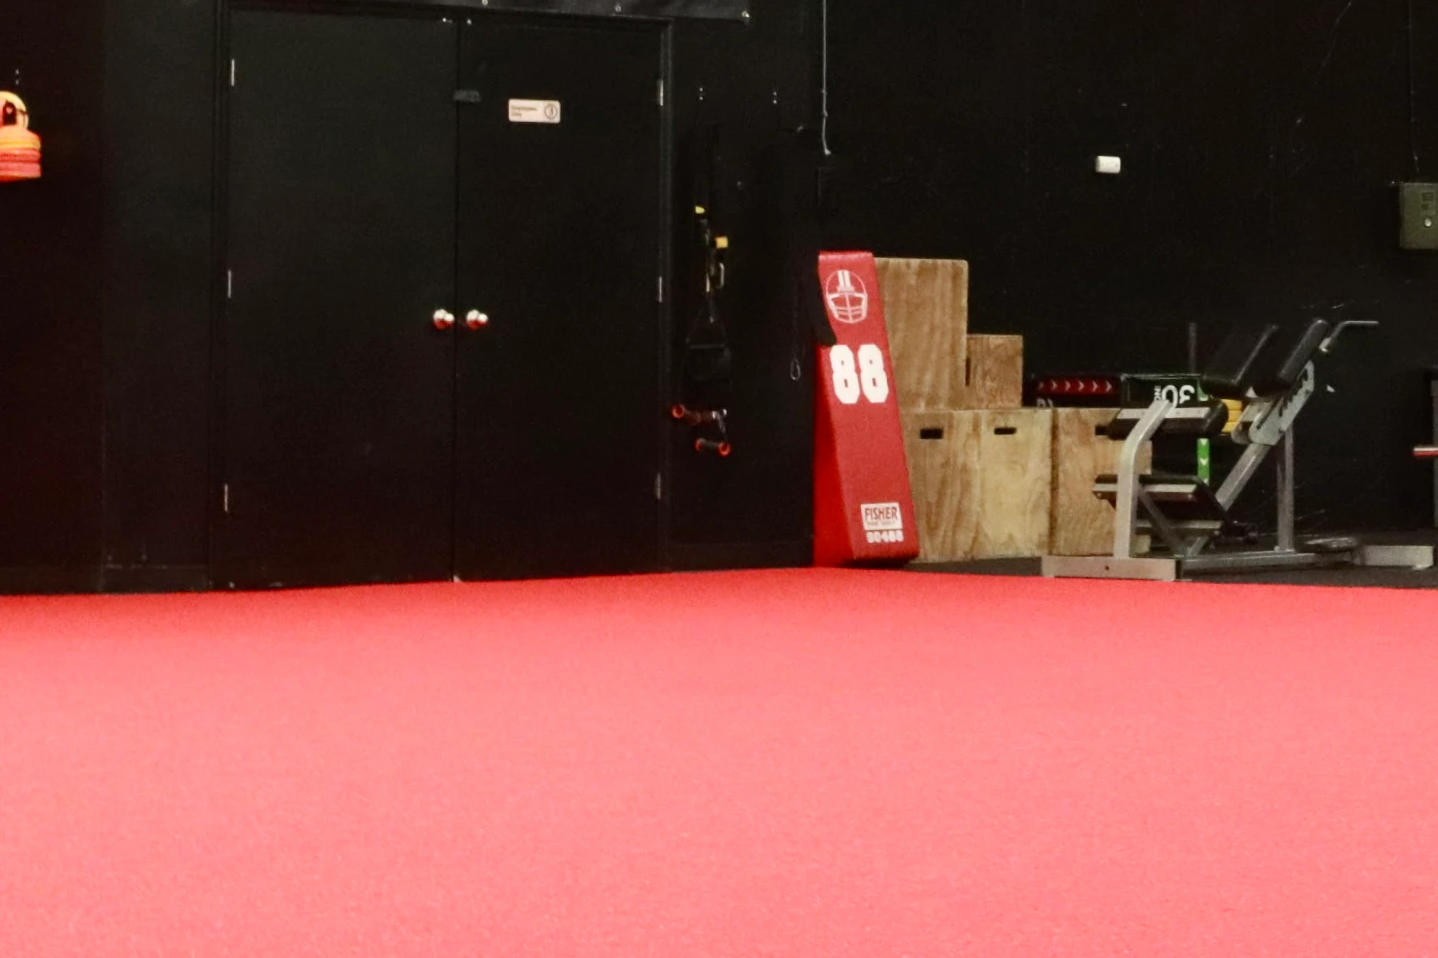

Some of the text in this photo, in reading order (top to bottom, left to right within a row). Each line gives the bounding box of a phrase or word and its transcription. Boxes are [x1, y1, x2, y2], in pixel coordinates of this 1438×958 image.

[829, 344, 889, 404] 88
[1162, 385, 1195, 408] 30
[864, 506, 898, 522] FISHER
